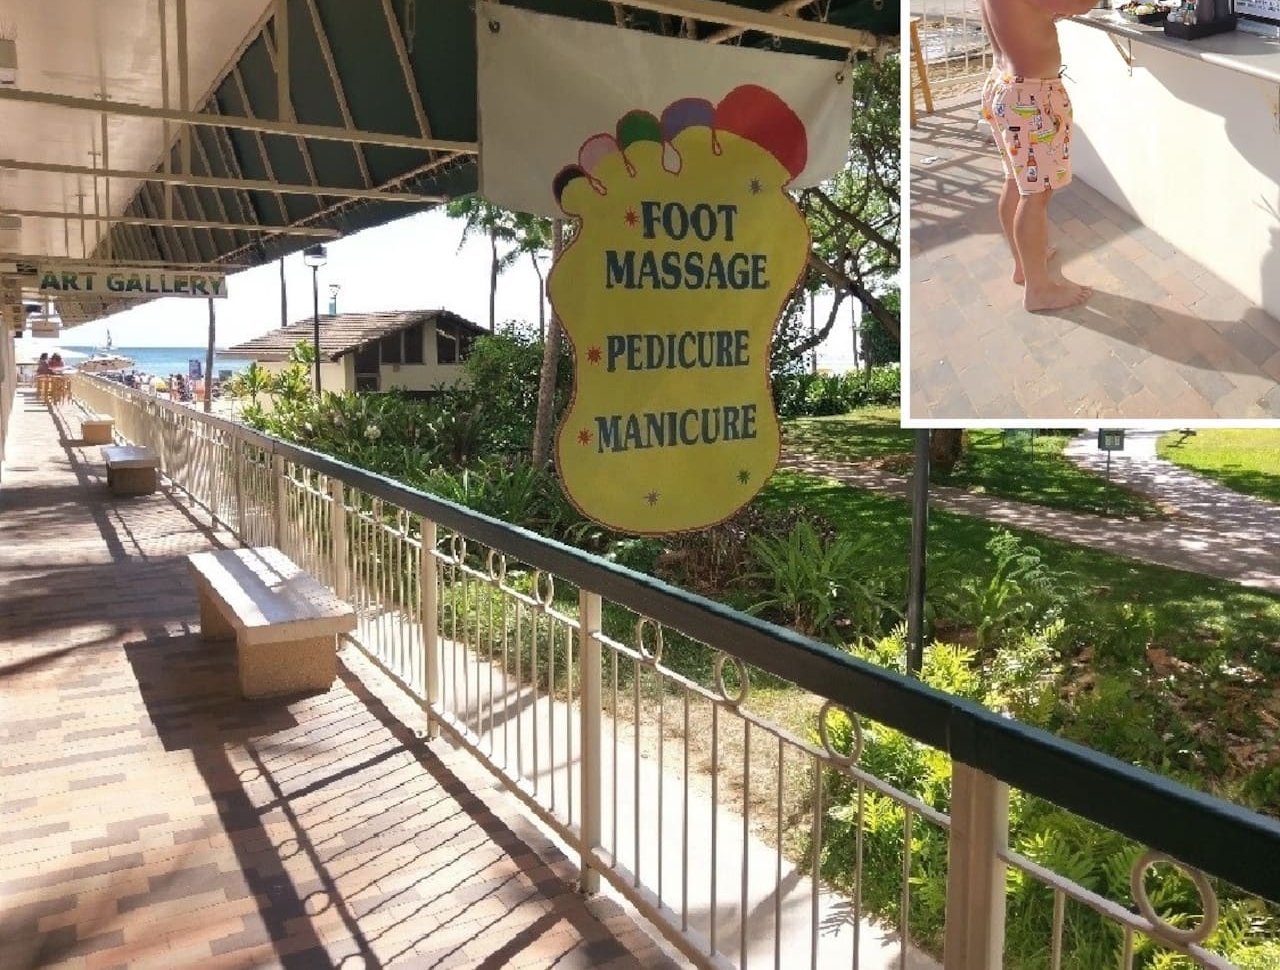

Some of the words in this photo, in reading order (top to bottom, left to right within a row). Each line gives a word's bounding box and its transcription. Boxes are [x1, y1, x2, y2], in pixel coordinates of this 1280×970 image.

[641, 200, 738, 242] FOOT
[40, 270, 97, 291] ART
[106, 272, 225, 296] GALLERY
[605, 249, 770, 290] MASSAGE
[606, 329, 751, 374] PEDICURE
[594, 403, 758, 454] MANICURE
